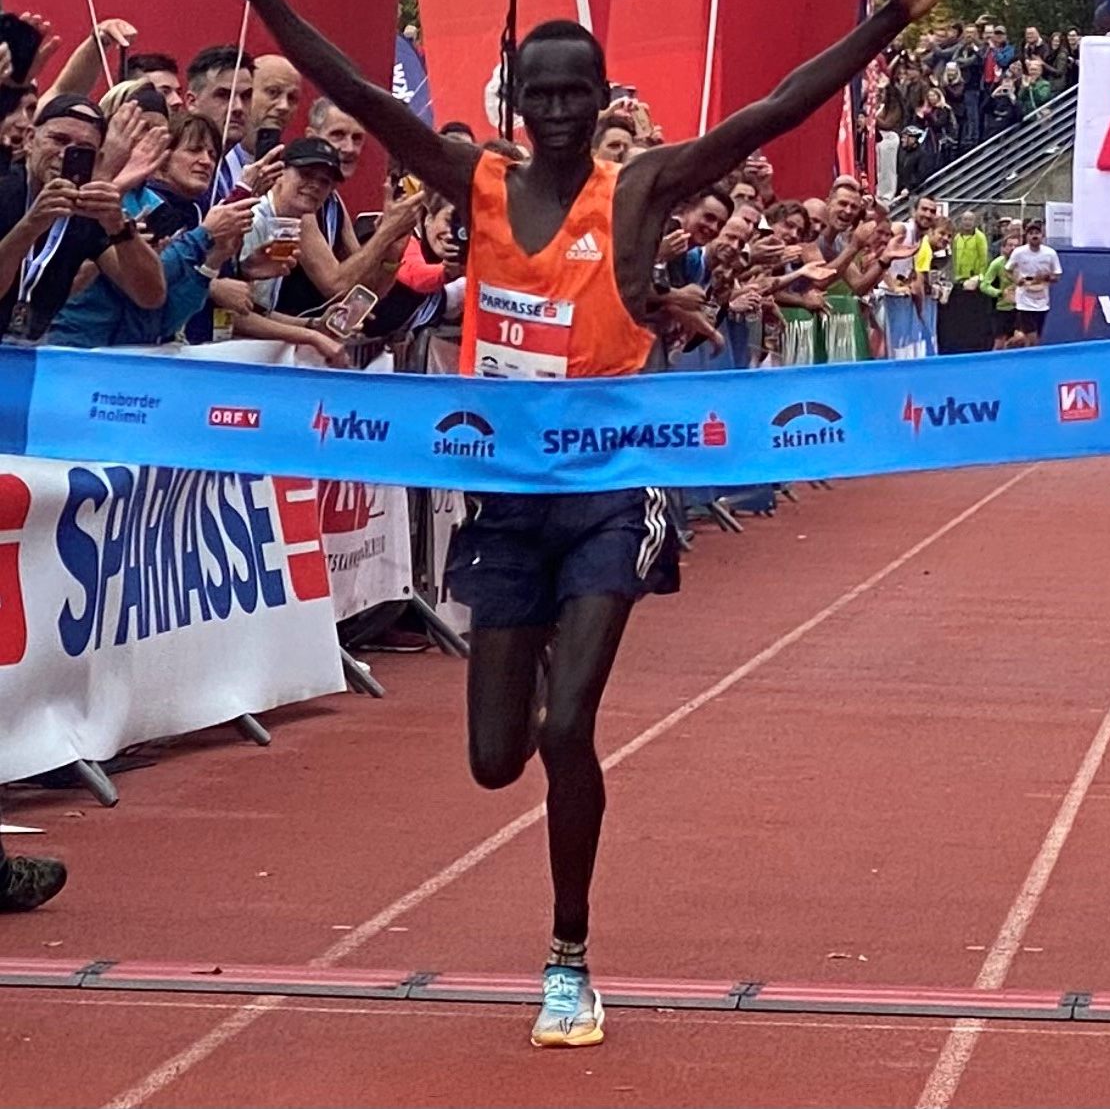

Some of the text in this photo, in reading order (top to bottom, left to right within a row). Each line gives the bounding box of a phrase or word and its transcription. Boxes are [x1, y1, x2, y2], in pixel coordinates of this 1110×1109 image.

[481, 292, 542, 318] PARKASSE
[499, 319, 525, 346] 10
[91, 391, 162, 409] #noborder
[925, 395, 1000, 427] vkw
[89, 407, 147, 425] #nolimit
[211, 412, 259, 426] ORF V
[332, 409, 391, 442] vkw
[433, 437, 496, 458] skinfit
[542, 422, 700, 455] SPARKASSE
[772, 426, 847, 449] skinfit
[56, 464, 287, 658] SPARKASSE
